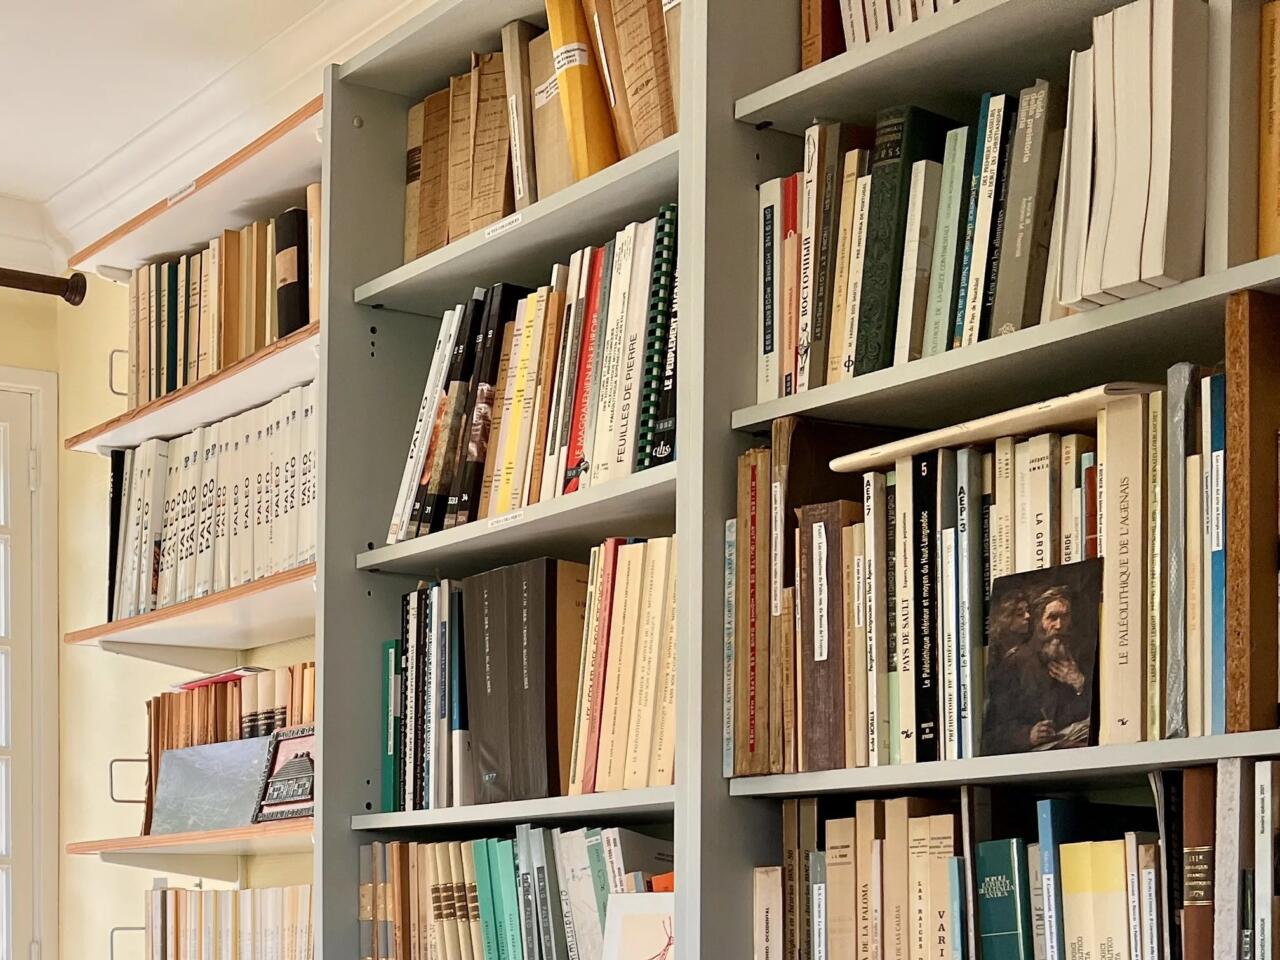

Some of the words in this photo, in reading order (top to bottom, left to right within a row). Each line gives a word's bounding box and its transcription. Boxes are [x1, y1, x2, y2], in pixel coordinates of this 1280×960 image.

[801, 236, 811, 317] ВОСТОЧНЫЙ
[588, 311, 598, 351] EUROPE
[665, 317, 678, 376] PEUPLEMENT
[624, 332, 637, 381] PIERRE
[622, 382, 633, 401] DE
[663, 378, 673, 391] LE
[409, 397, 429, 459] PALEO
[616, 402, 631, 463] FEUILLES
[920, 462, 928, 477] 5
[188, 485, 197, 558] PALEO
[198, 483, 209, 555] PALEO
[205, 478, 215, 550] PALEO
[1036, 513, 1044, 526] LA
[1119, 476, 1130, 536] L'AGENAIS
[179, 489, 188, 561] PALEO
[920, 510, 930, 564] Haut-Languedoc
[1036, 532, 1044, 570] GROTT
[1064, 533, 1072, 562] GERDE
[1119, 538, 1129, 555] DE
[921, 564, 929, 574] du
[922, 575, 931, 598] moyen
[1117, 557, 1131, 648] PALÉOLITHIQUE
[901, 597, 910, 631] SAULT
[921, 607, 930, 635] inférieur
[902, 632, 909, 645] DE
[902, 648, 910, 672] PAYS
[921, 636, 931, 678] Paléolithique
[1118, 651, 1129, 665] LE
[922, 678, 931, 688] Le
[947, 678, 953, 689] DE
[861, 883, 869, 921] PALOMA
[861, 925, 869, 937] LA
[1033, 905, 1045, 937] TOME
[861, 940, 869, 953] DE
[895, 947, 902, 957] DE
